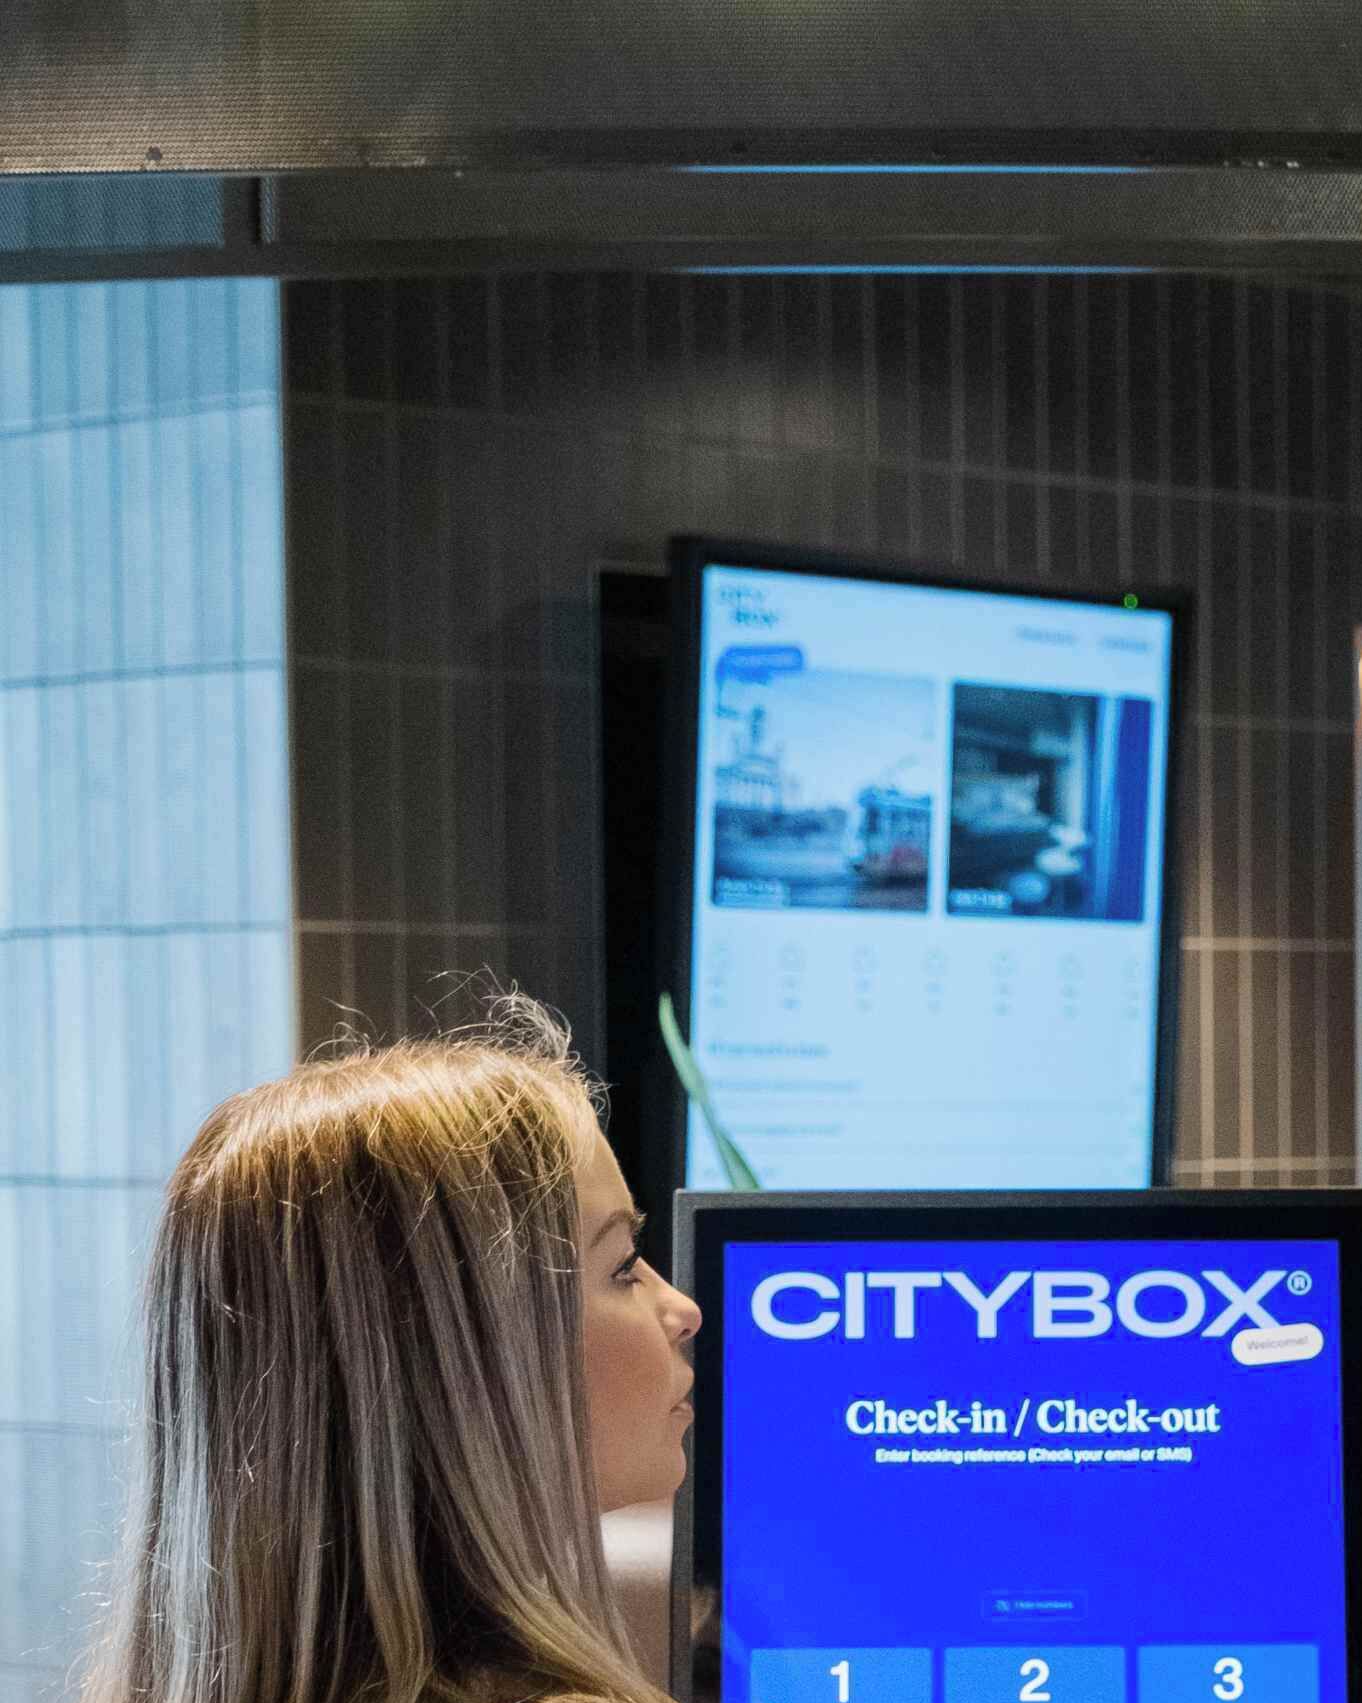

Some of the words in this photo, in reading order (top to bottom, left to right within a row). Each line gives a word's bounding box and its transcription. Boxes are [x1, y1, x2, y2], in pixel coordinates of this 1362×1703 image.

[846, 1399, 1007, 1434] Check-in
[1013, 1398, 1031, 1438] /
[1036, 1398, 1221, 1434] Check-out
[911, 1449, 963, 1465] booking
[830, 1661, 849, 1703] 1
[1020, 1659, 1050, 1701] 2
[1214, 1658, 1243, 1700] 3
